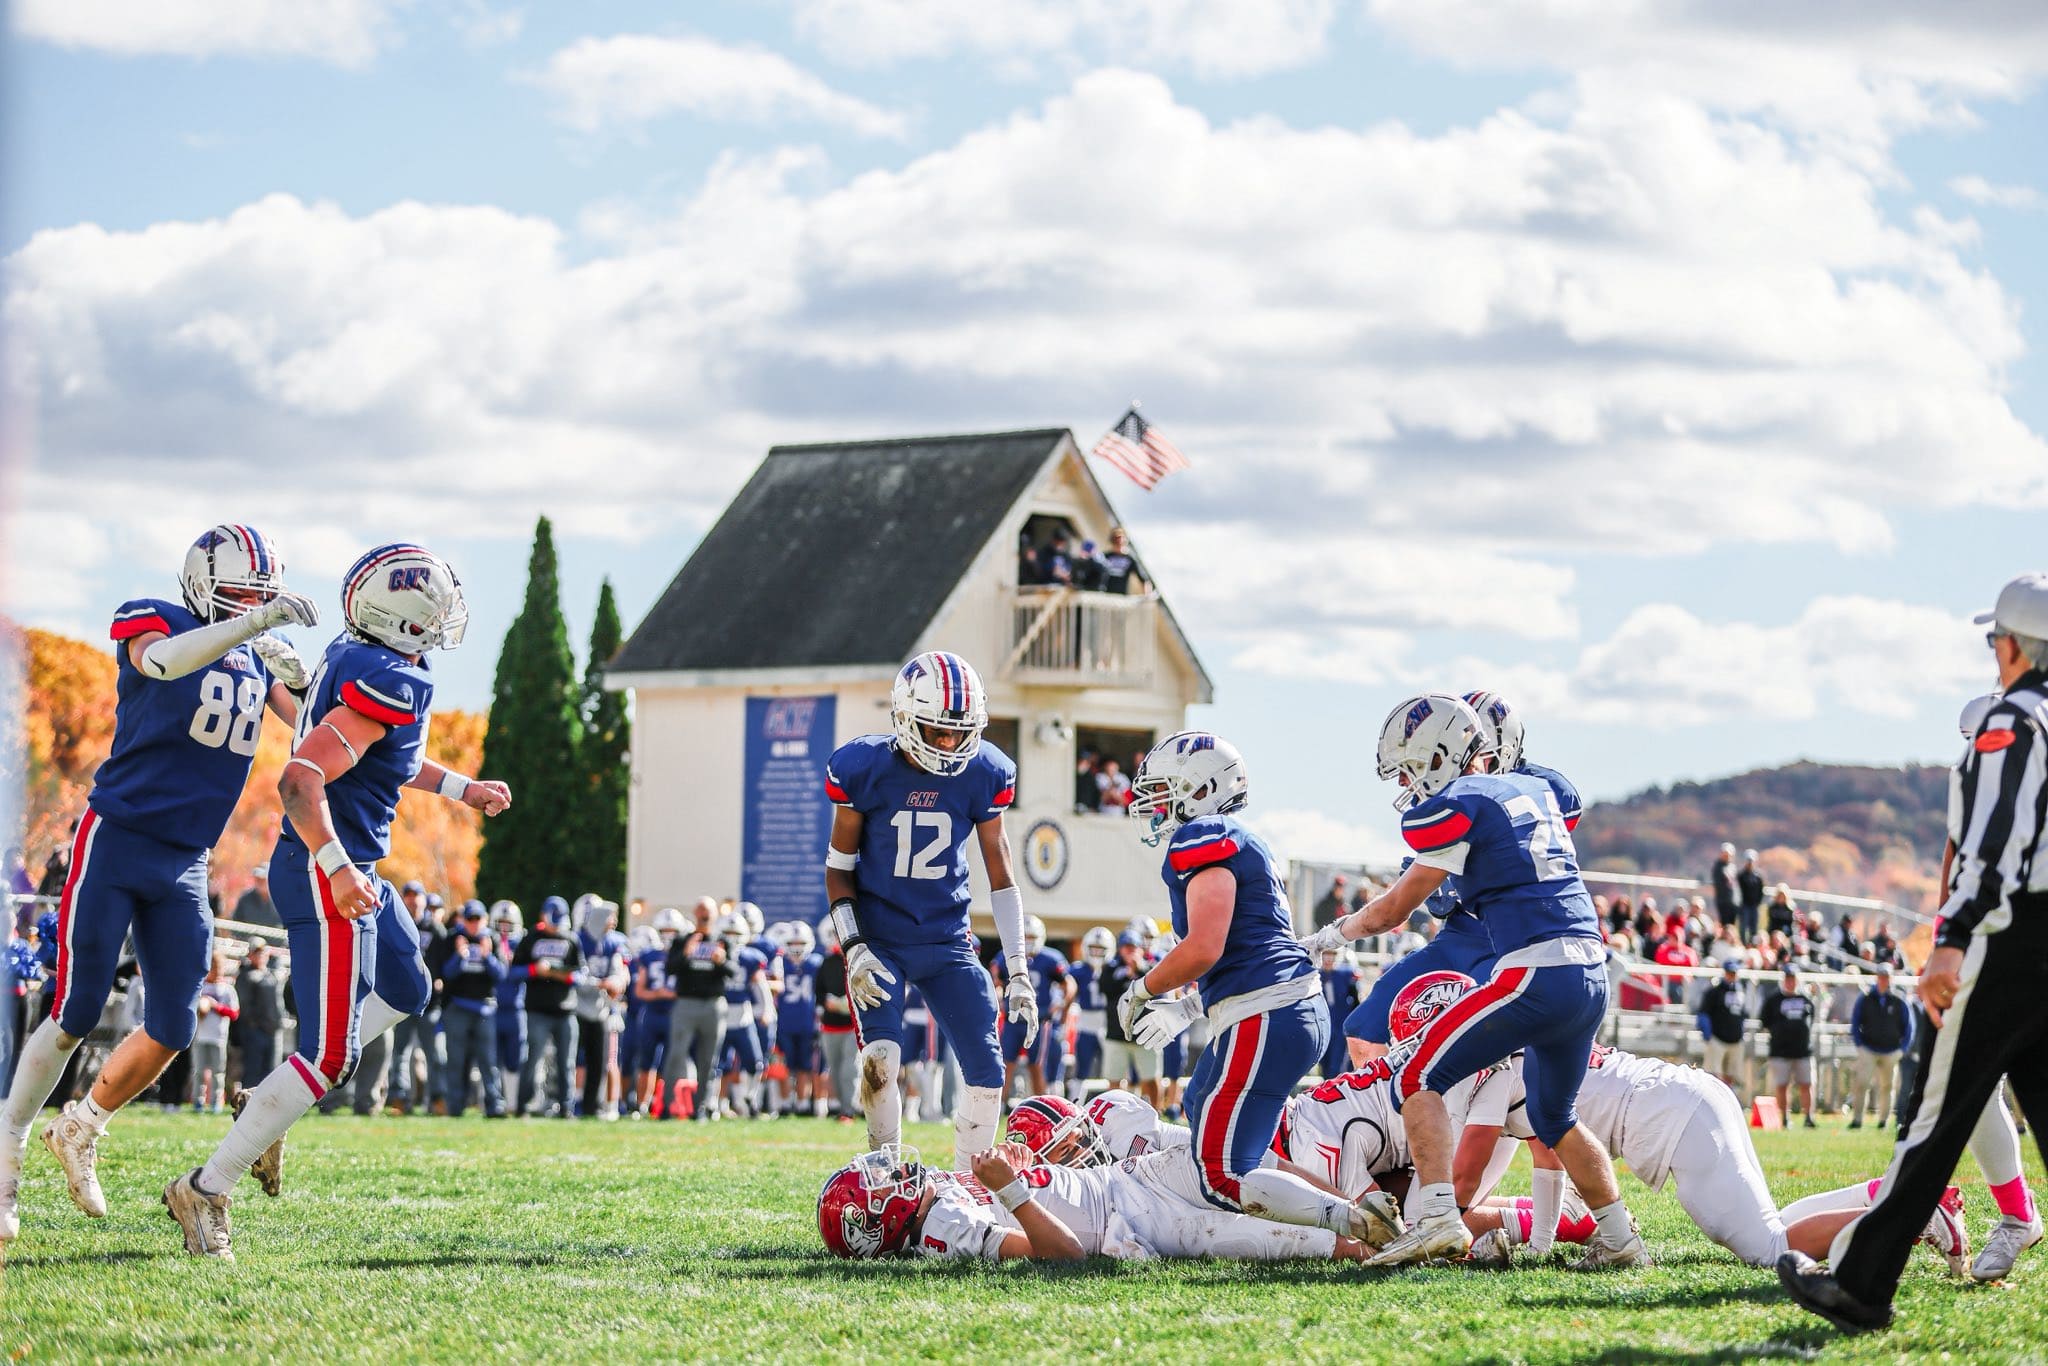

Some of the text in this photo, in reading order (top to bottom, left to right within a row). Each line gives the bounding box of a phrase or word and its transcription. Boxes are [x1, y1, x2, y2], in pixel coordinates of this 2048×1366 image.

[189, 669, 267, 757] 88
[906, 791, 939, 808] GNH
[890, 810, 952, 880] 12
[785, 974, 814, 1003] 54
